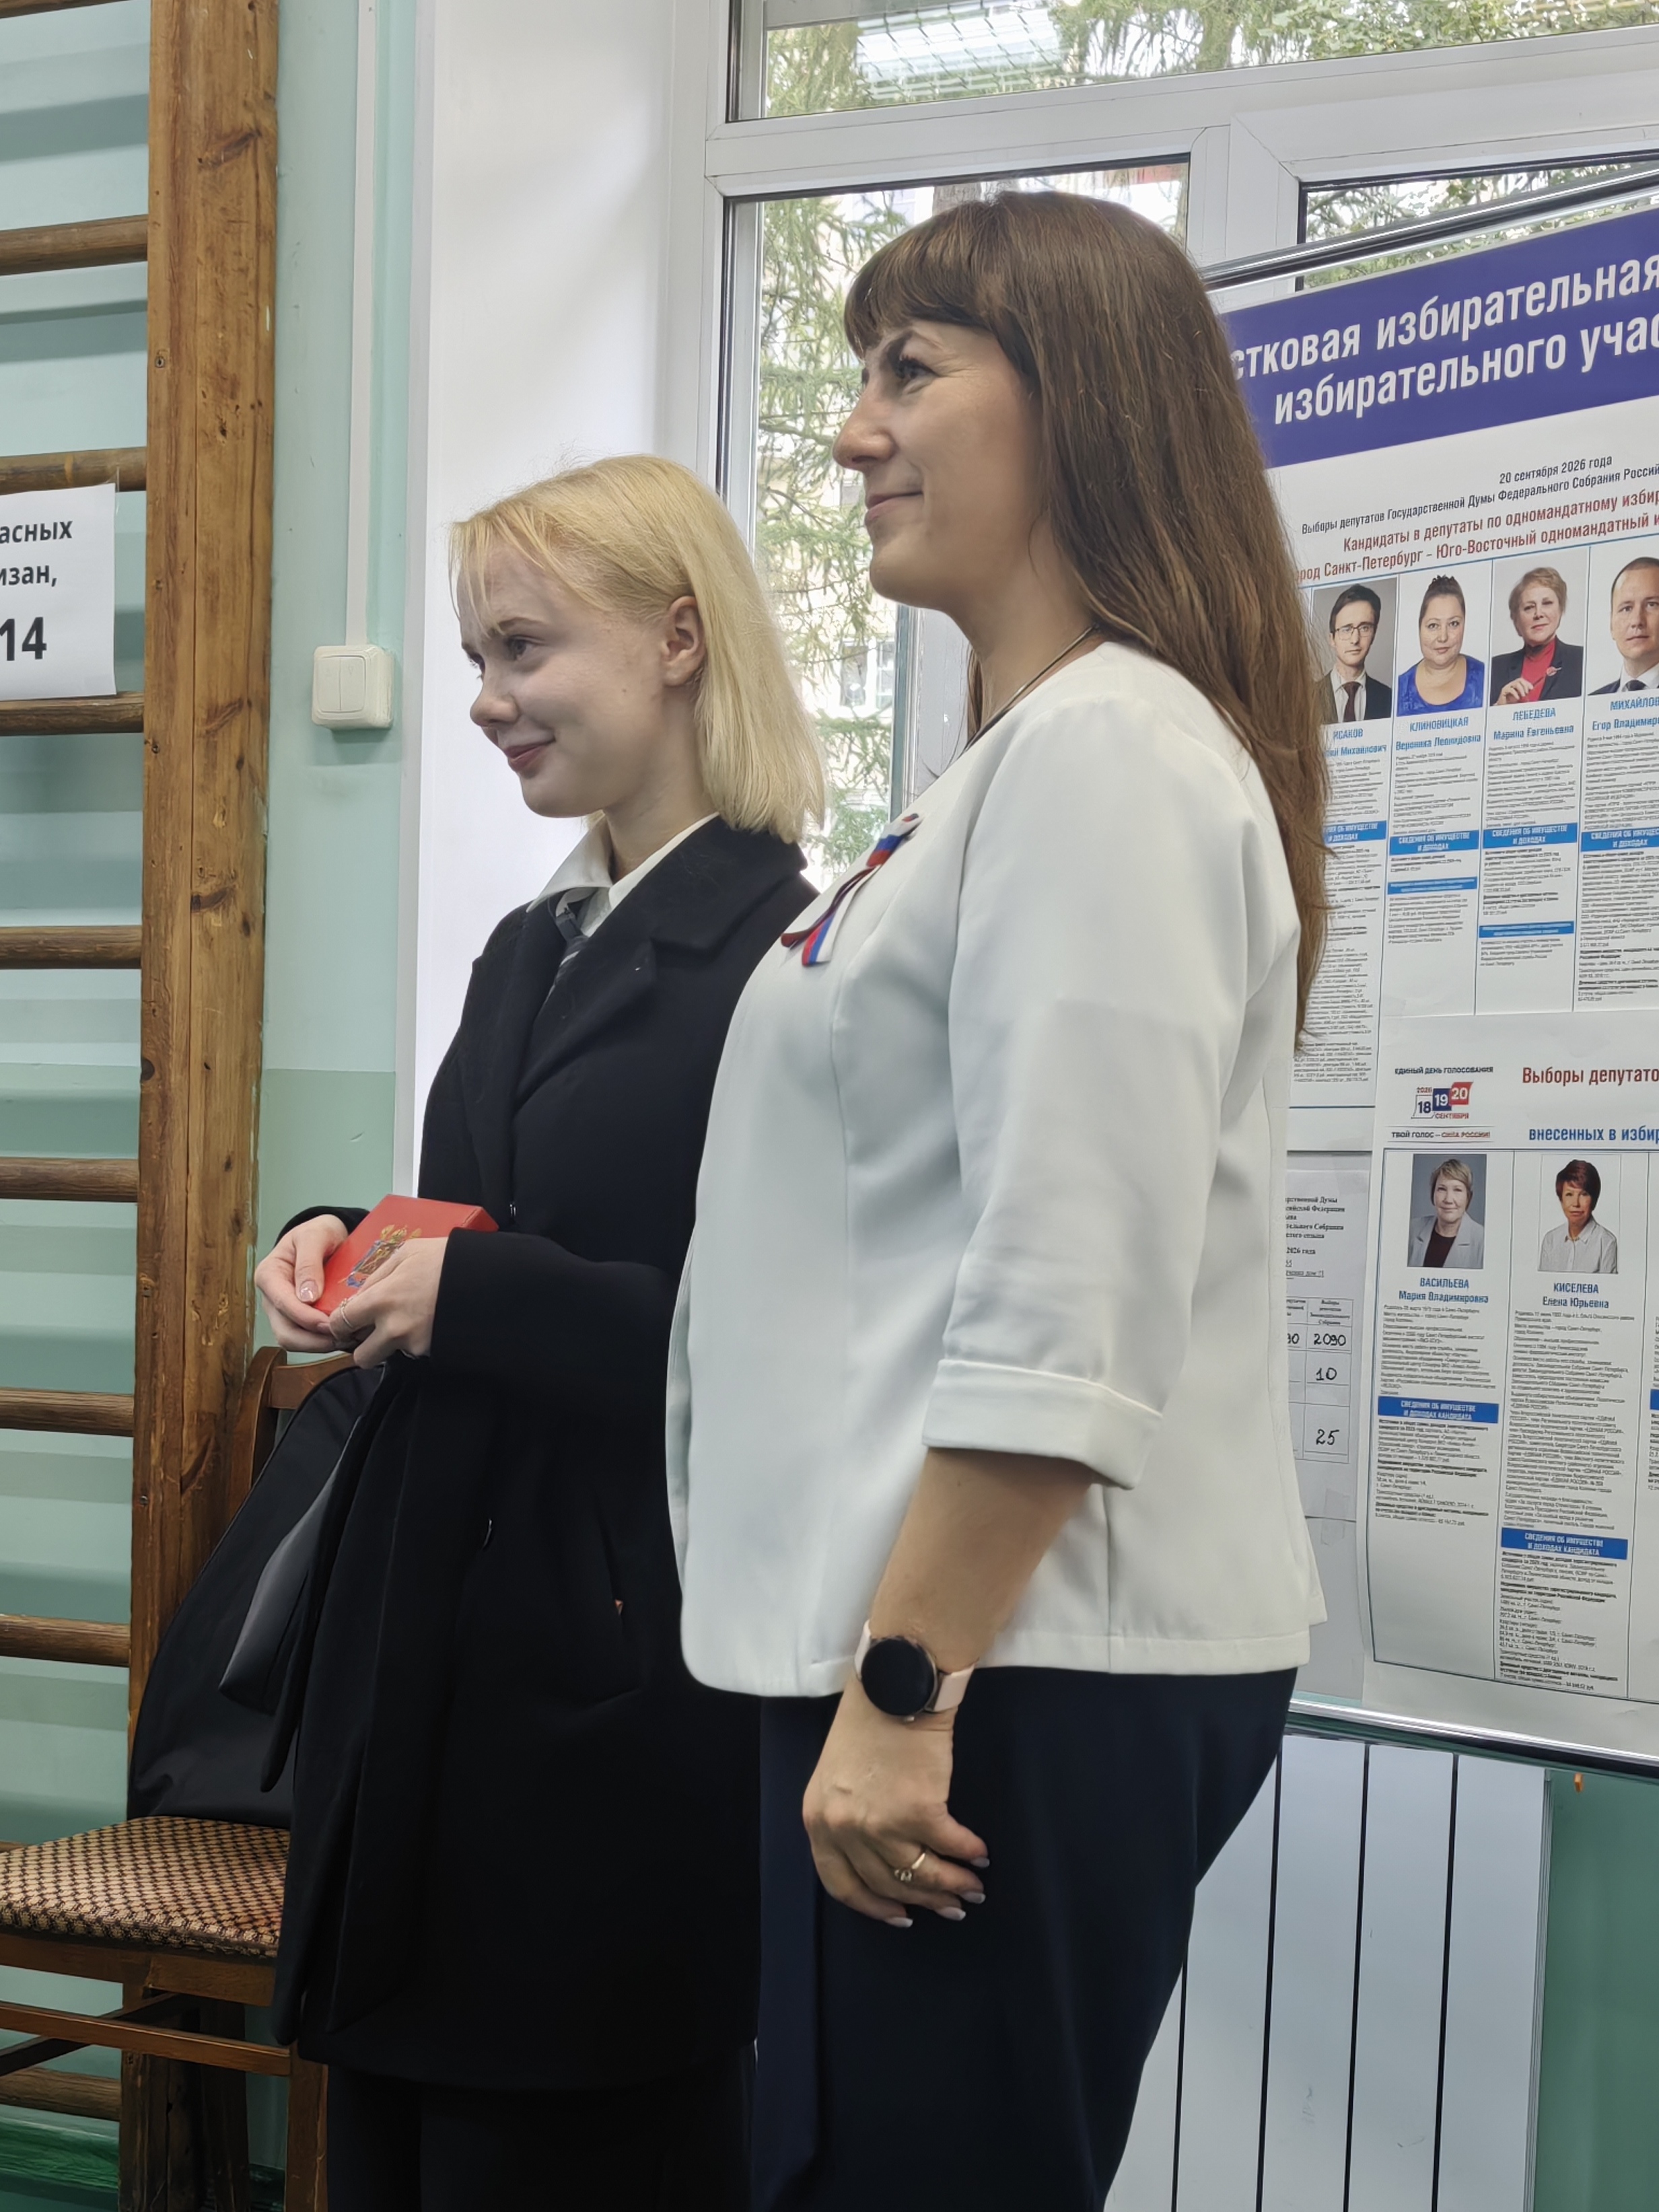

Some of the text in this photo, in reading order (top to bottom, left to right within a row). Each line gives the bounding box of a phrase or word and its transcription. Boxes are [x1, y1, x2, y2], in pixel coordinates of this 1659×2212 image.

[1230, 254, 1659, 381] стковая избирательная
[1275, 332, 1566, 425] избирательного
[1499, 456, 1612, 484] 20 сентября 2026 года
[1302, 520, 1337, 534] Выборы
[1339, 512, 1385, 530] депутатов
[1387, 497, 1464, 521] Государственной
[1468, 493, 1495, 508] Думы
[1498, 480, 1569, 501] Федерального
[1572, 472, 1620, 489] Собрания
[1343, 530, 1409, 552] Кандидаты
[1414, 529, 1419, 540] в
[1423, 519, 1483, 542] депутаты
[1487, 516, 1501, 529] по
[1506, 496, 1617, 527] одномандатному
[0, 521, 73, 544] асных
[1324, 550, 1423, 577] Санкт-Петербург
[1436, 530, 1536, 559] Юго-Восточный
[1541, 513, 1649, 544] одномандатный
[0, 616, 47, 662] 14
[1512, 708, 1556, 721] ЛЕБЕДЕВА
[1592, 721, 1611, 731] Егор
[1395, 1067, 1423, 1075] ЕДИНЫЙ
[1522, 1067, 1659, 1087] Выборы депутато
[1417, 1087, 1469, 1114] 18 19 20
[1391, 1131, 1410, 1139] ТВОЙ
[1528, 1129, 1604, 1141] внесенных
[1609, 1129, 1616, 1141] в
[1419, 1277, 1469, 1289] ВАСИЛЬЕВА
[1553, 1283, 1599, 1294] КИСЕЛЕВА
[1399, 1290, 1489, 1304] Мария Владимировна
[1543, 1296, 1609, 1309] Елена Юрьевна
[1314, 1333, 1346, 1347] 2090
[1316, 1367, 1337, 1381] 10
[1316, 1429, 1339, 1446] 25
